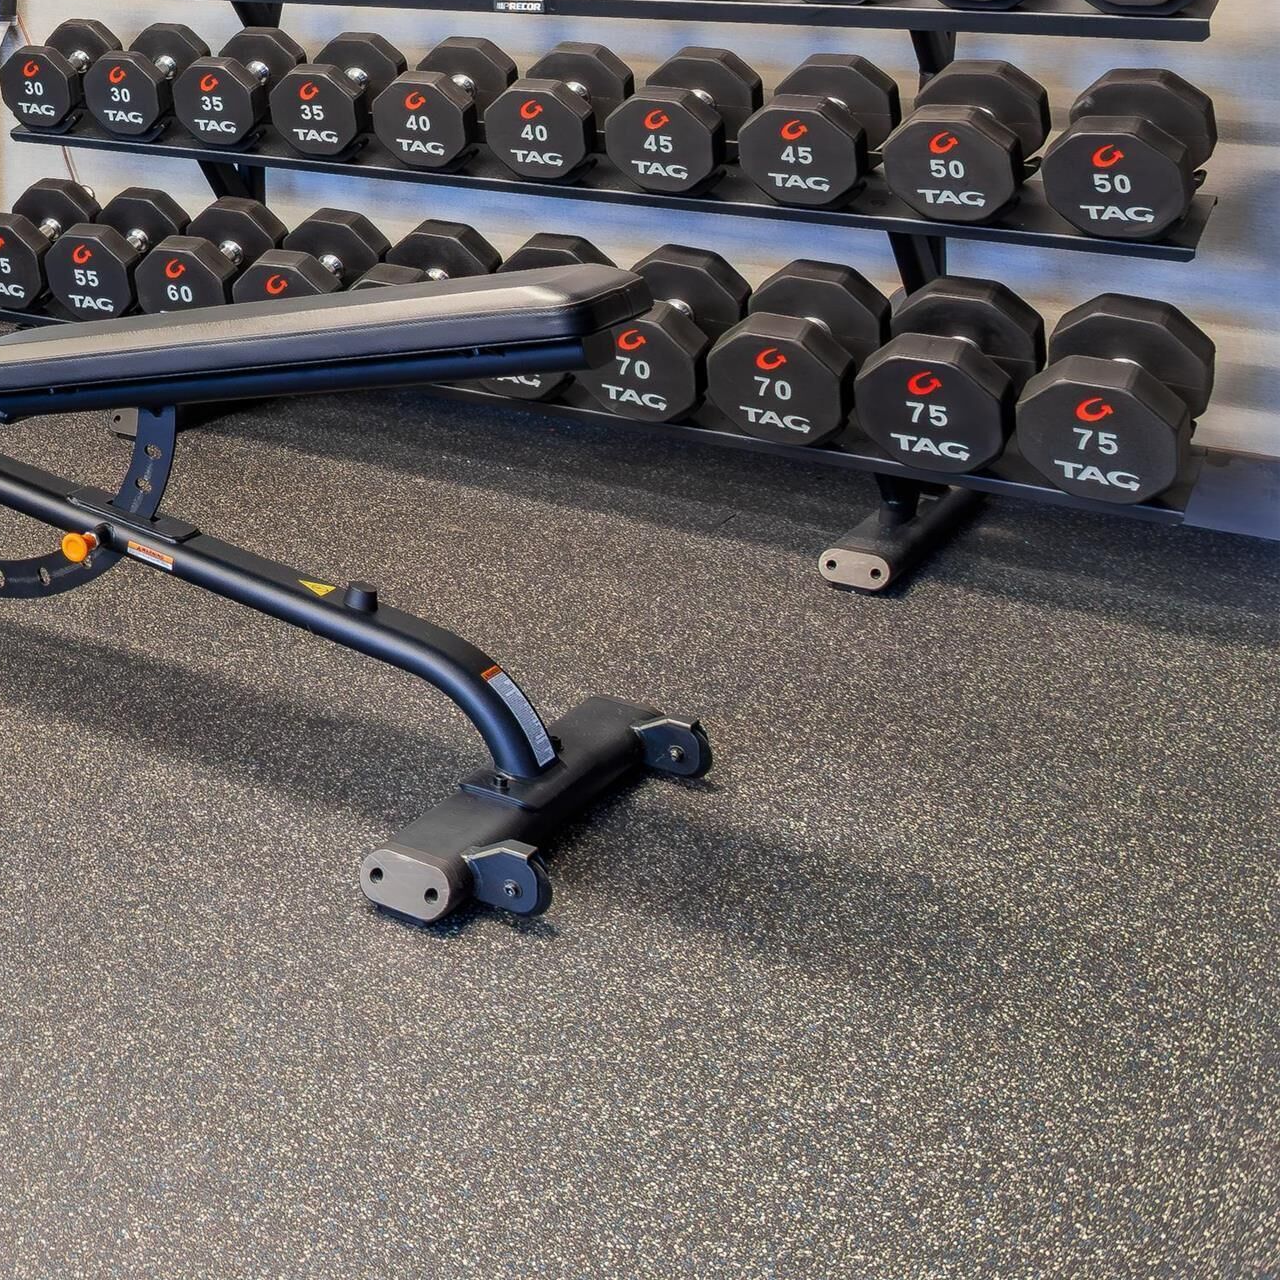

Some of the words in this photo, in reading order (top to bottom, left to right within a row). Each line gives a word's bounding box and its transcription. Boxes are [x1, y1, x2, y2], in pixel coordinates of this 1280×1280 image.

[25, 81, 43, 95] 30
[111, 88, 130, 102] 30
[18, 103, 55, 116] TAG
[201, 96, 223, 111] 35
[104, 110, 143, 124] TAG
[301, 105, 324, 120] 35
[194, 119, 236, 133] TAG
[406, 115, 430, 131] 40
[293, 129, 338, 143] TAG
[521, 124, 547, 141] 40
[396, 139, 444, 155] TAG
[644, 135, 672, 153] 45
[510, 149, 563, 166] TAG
[781, 146, 812, 164] 45
[631, 160, 688, 179] TAG
[930, 160, 964, 178] 50
[768, 173, 830, 191] TAG
[1093, 174, 1131, 193] 50
[917, 189, 985, 207] TAG
[1080, 205, 1154, 222] TAG
[74, 269, 98, 287] 55
[167, 285, 192, 302] 60
[68, 295, 113, 312] TAG
[616, 356, 650, 379] 70
[492, 375, 540, 387] AG
[754, 376, 791, 400] 70
[602, 384, 667, 411] TAG
[740, 406, 810, 433] TAG
[906, 401, 947, 426] 75
[891, 433, 970, 461] TAG
[1073, 428, 1118, 454] 75
[1054, 460, 1140, 491] TAG
